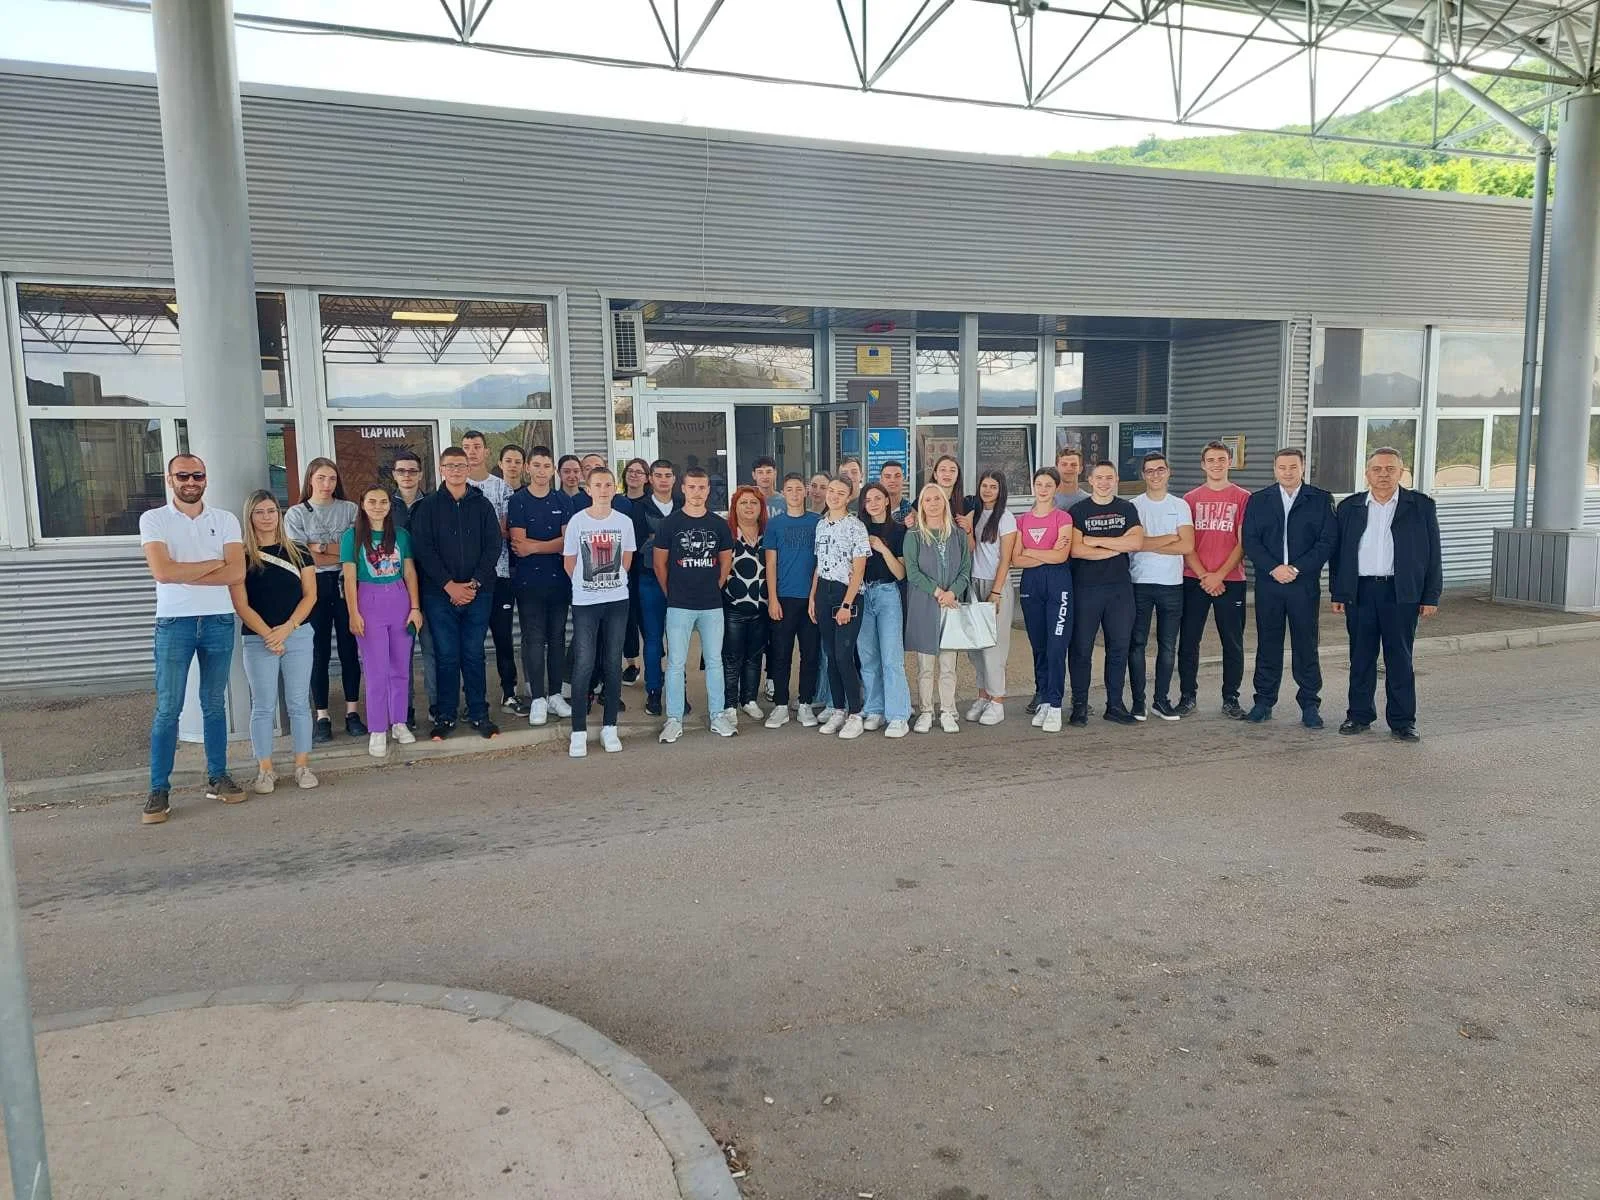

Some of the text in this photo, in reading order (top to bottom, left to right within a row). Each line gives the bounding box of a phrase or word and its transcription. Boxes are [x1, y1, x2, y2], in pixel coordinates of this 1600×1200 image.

[360, 427, 406, 439] ЦАРИНА
[1195, 520, 1233, 532] BELIEVER
[580, 532, 622, 544] FUTURE
[1055, 591, 1069, 636] GIVOVA
